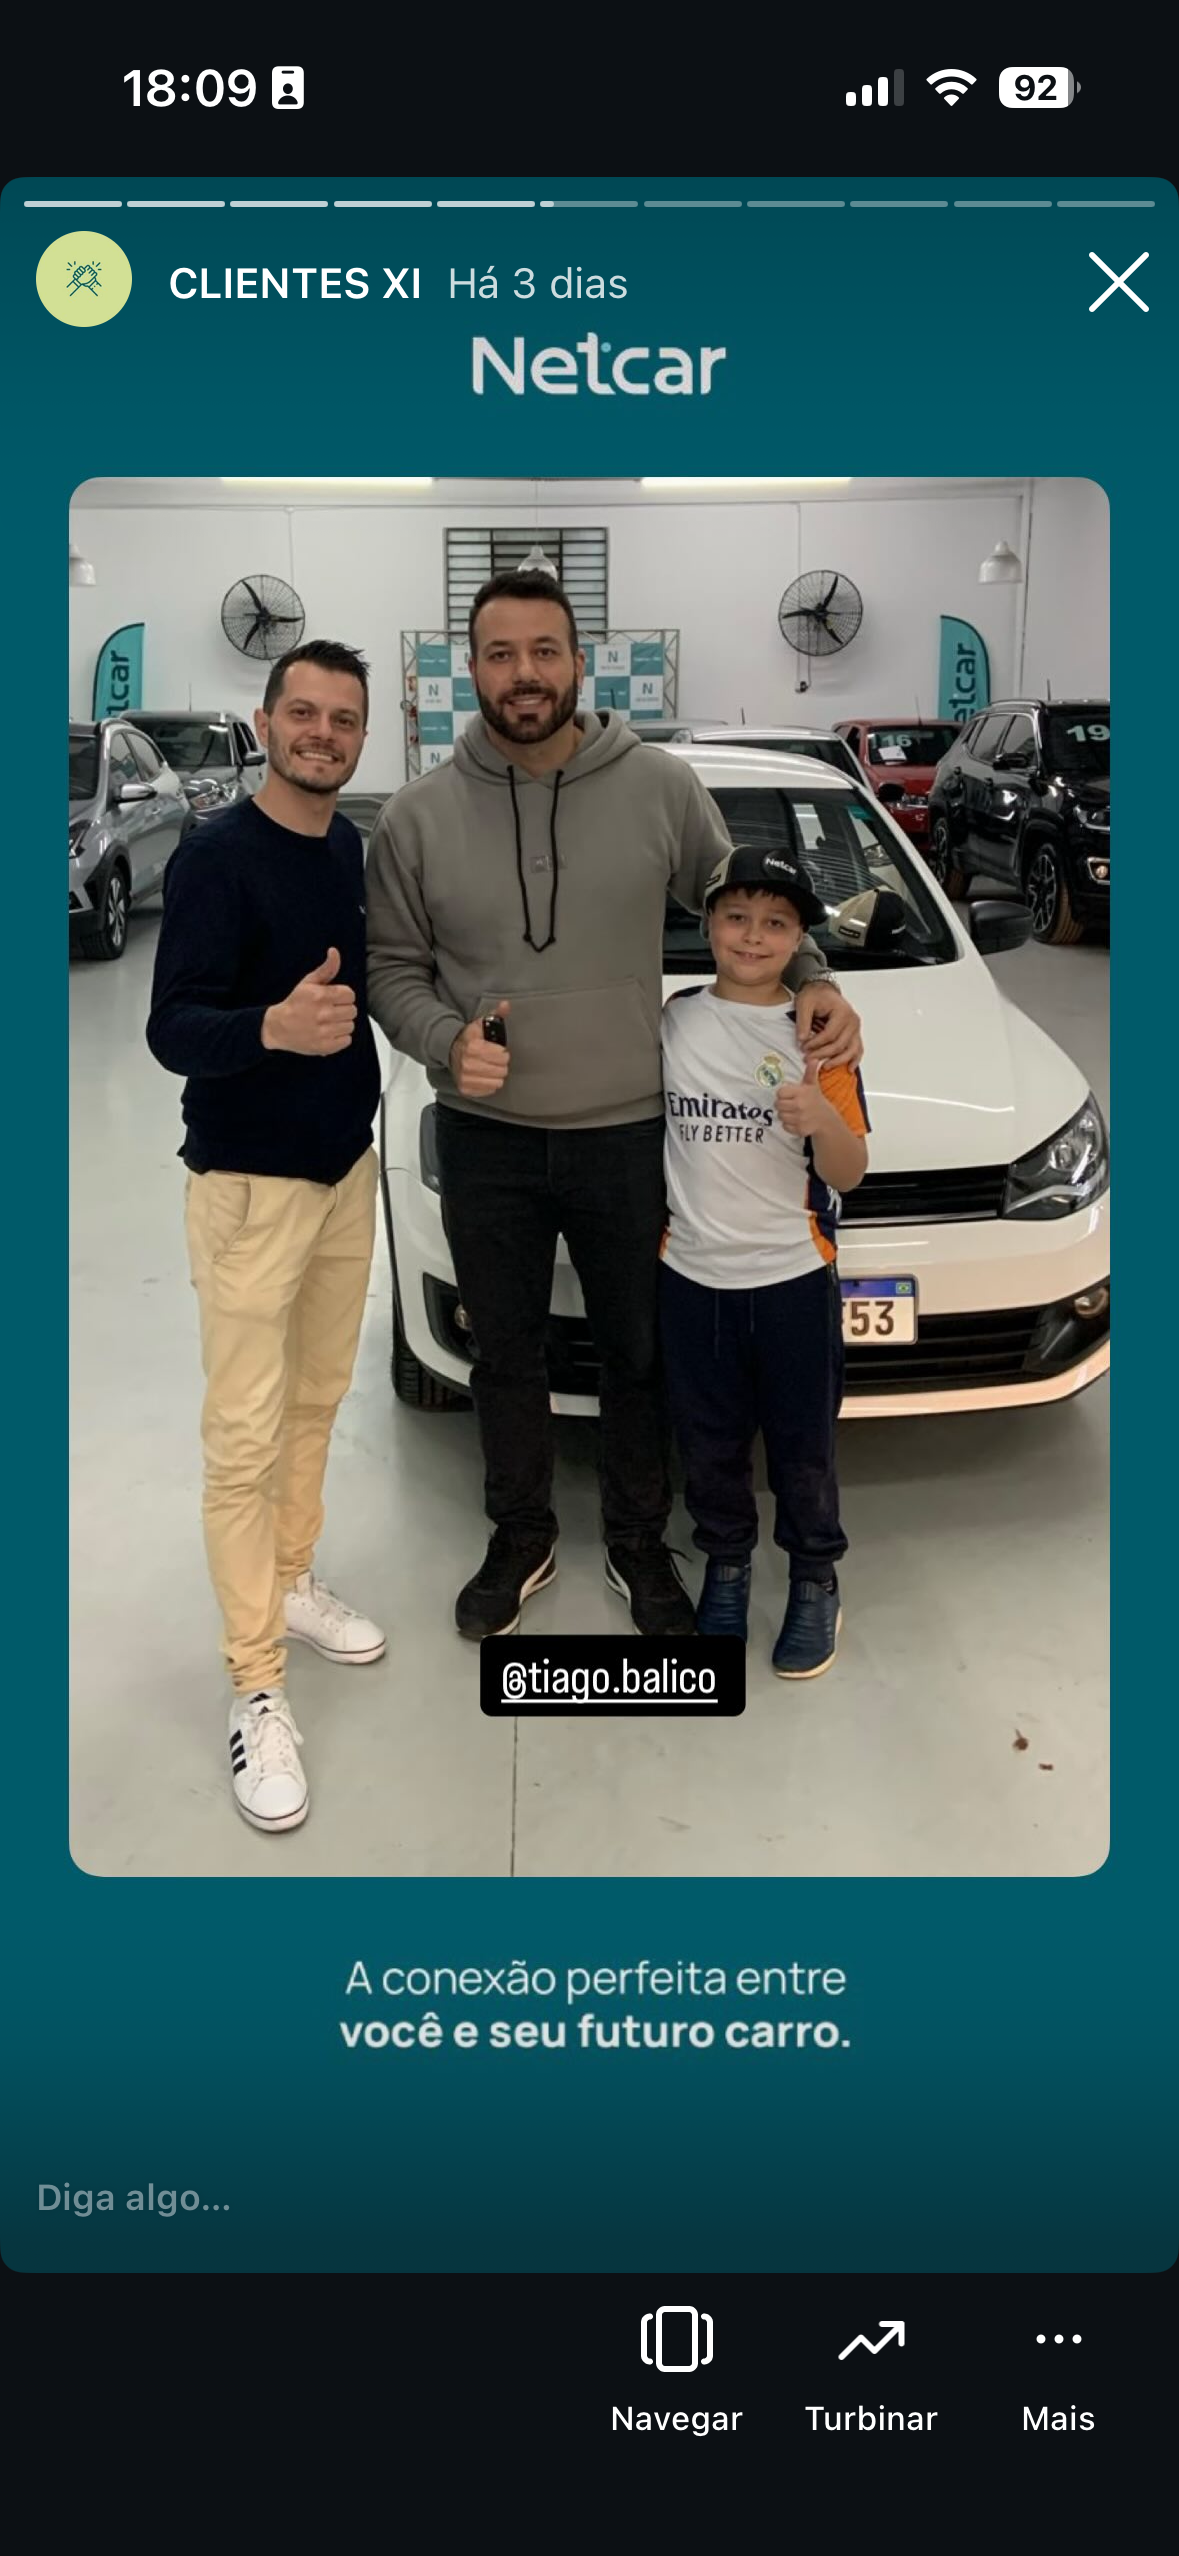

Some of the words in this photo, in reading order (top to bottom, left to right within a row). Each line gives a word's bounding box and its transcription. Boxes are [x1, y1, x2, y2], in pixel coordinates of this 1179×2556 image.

[106, 649, 130, 716] tcar
[948, 642, 976, 722] etcar
[1066, 724, 1110, 742] 19
[667, 1091, 775, 1127] Emirates
[680, 1124, 699, 1142] FLY
[703, 1125, 764, 1143] BETTER
[843, 1300, 895, 1336] 53
